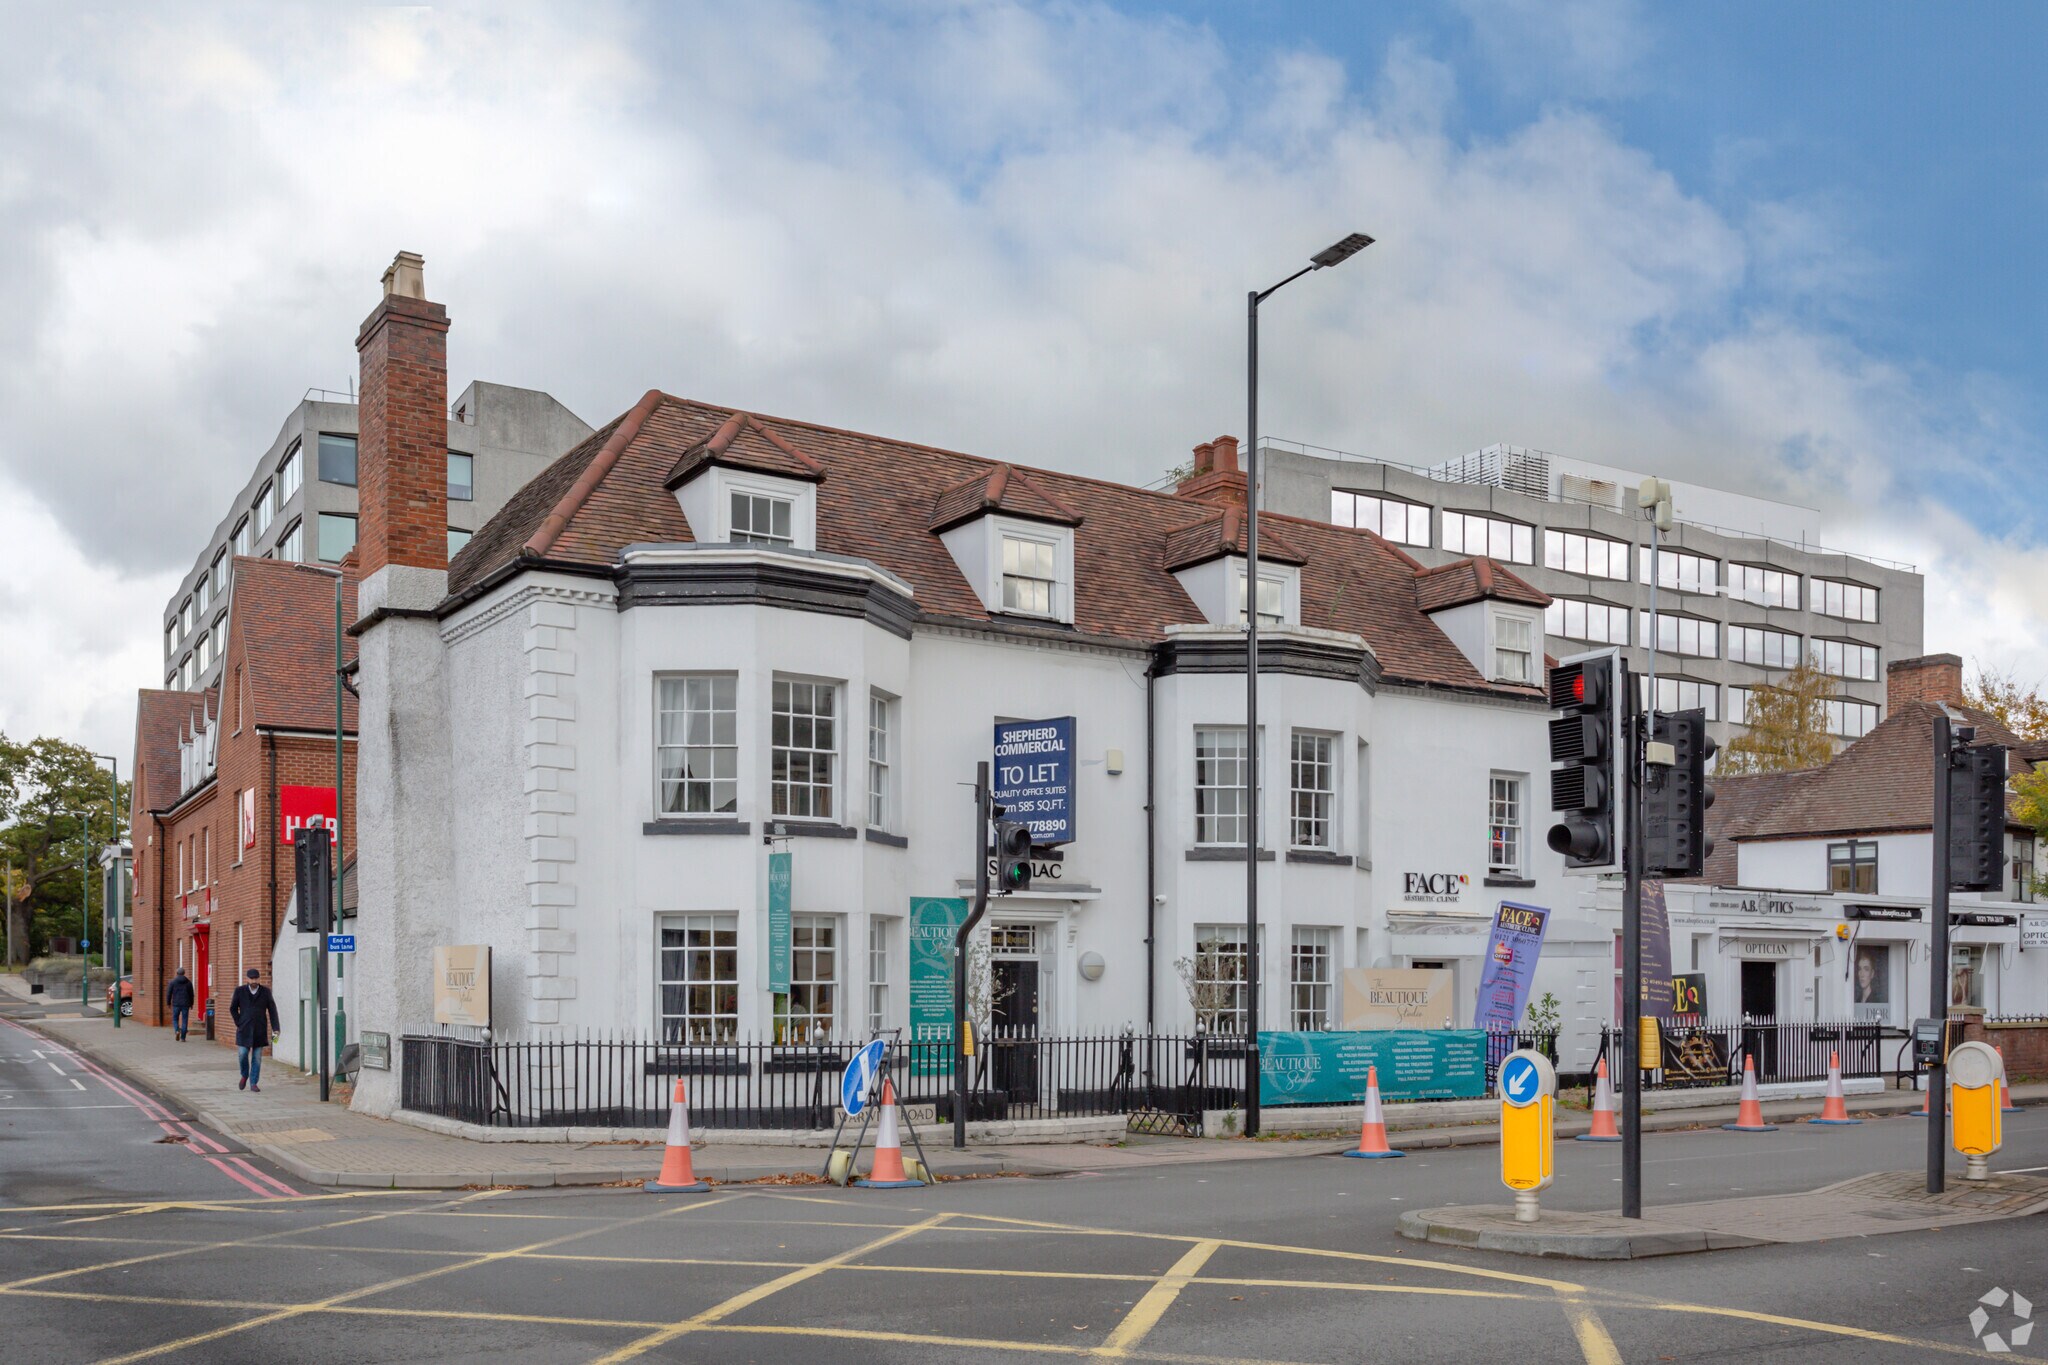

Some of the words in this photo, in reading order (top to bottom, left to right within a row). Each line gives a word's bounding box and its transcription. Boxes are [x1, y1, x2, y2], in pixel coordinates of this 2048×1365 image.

[1002, 727, 1057, 744] SHEPHERD
[994, 739, 1066, 757] COMMERCIAL
[1000, 766, 1024, 785] TO
[1029, 763, 1059, 783] LET
[994, 789, 1020, 799] QUALITY
[1022, 787, 1044, 796] OFFICE
[1045, 786, 1066, 795] SUITES
[1018, 800, 1035, 812] 585
[1027, 819, 1066, 832] 778890
[1404, 873, 1460, 895] FACE
[1741, 899, 1758, 912] A.B.
[1500, 907, 1534, 927] FACE
[910, 926, 960, 940] EAUTIQU
[1745, 943, 1788, 954] OPTICIAN
[1370, 991, 1428, 1006] BEAUTIQUE
[1395, 1004, 1423, 1024] Studio
[1259, 1057, 1322, 1072] BEAUTIQUE
[838, 1110, 881, 1123] WARWI
